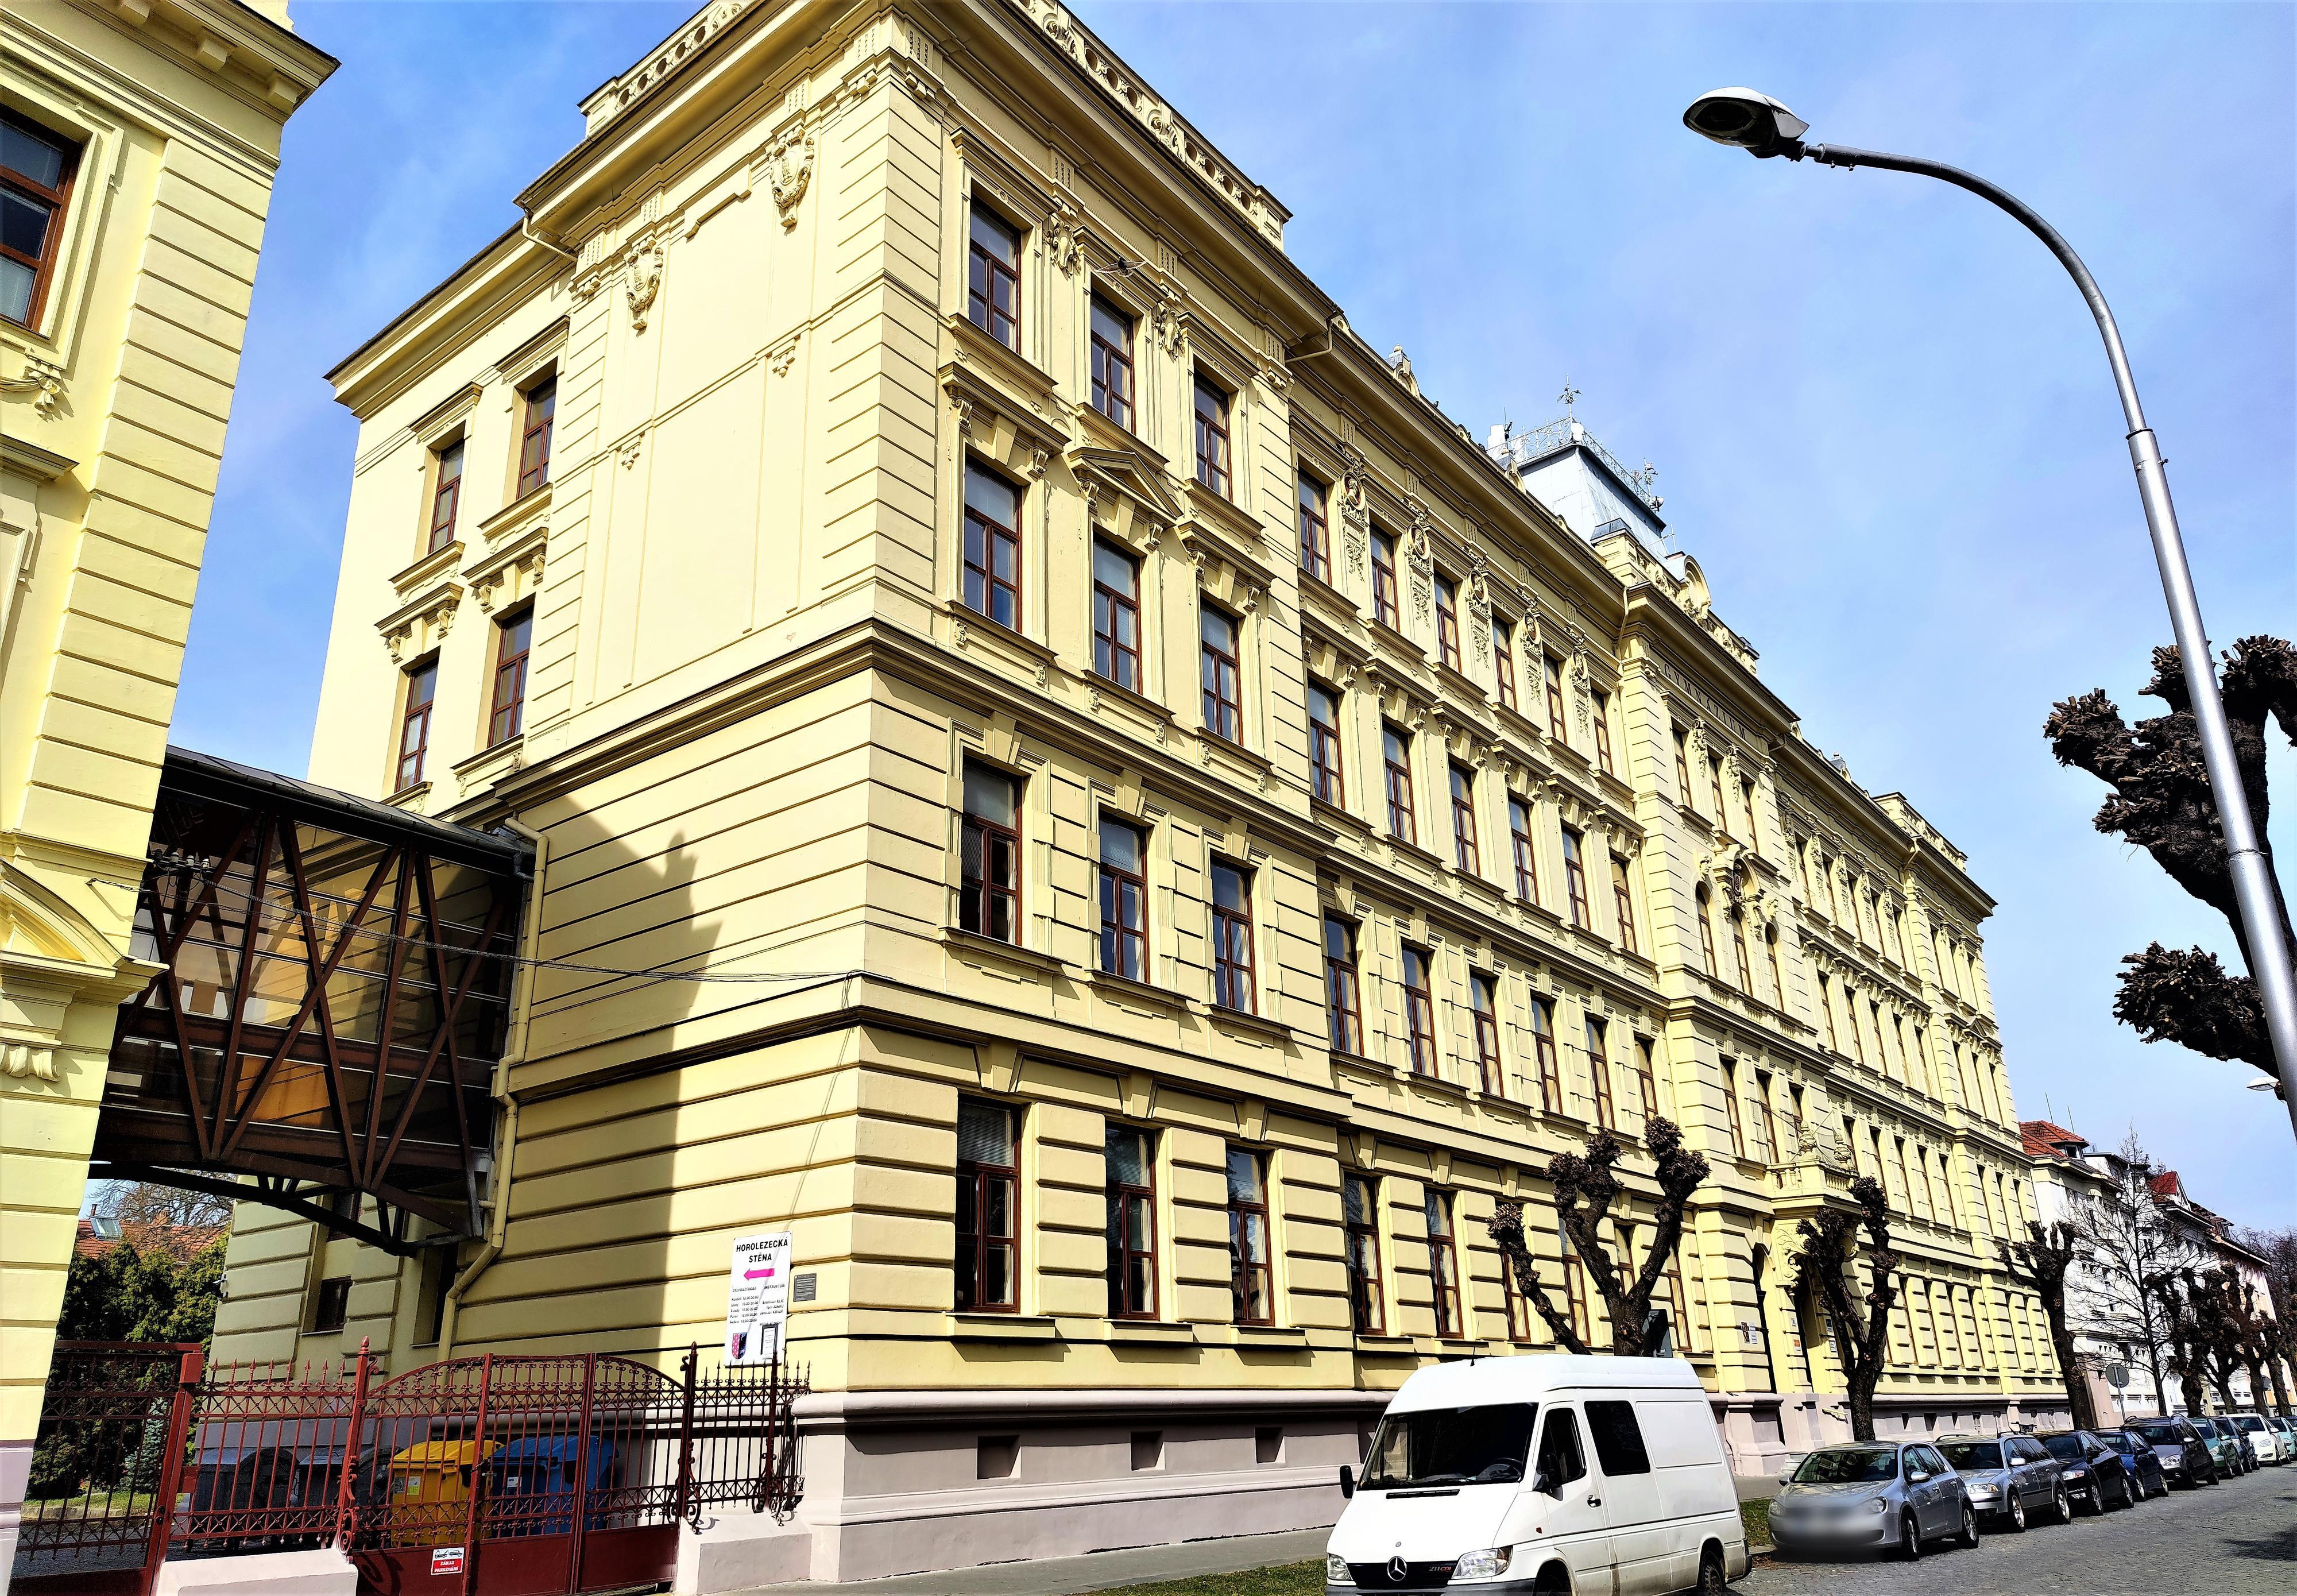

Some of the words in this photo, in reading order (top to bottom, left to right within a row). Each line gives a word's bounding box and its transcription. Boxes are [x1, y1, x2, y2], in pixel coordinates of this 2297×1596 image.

[1664, 663, 1746, 740] GYMNÁZIUM
[736, 1236, 788, 1253] HOROLEZECKÁ
[749, 1252, 772, 1263] STĚNA
